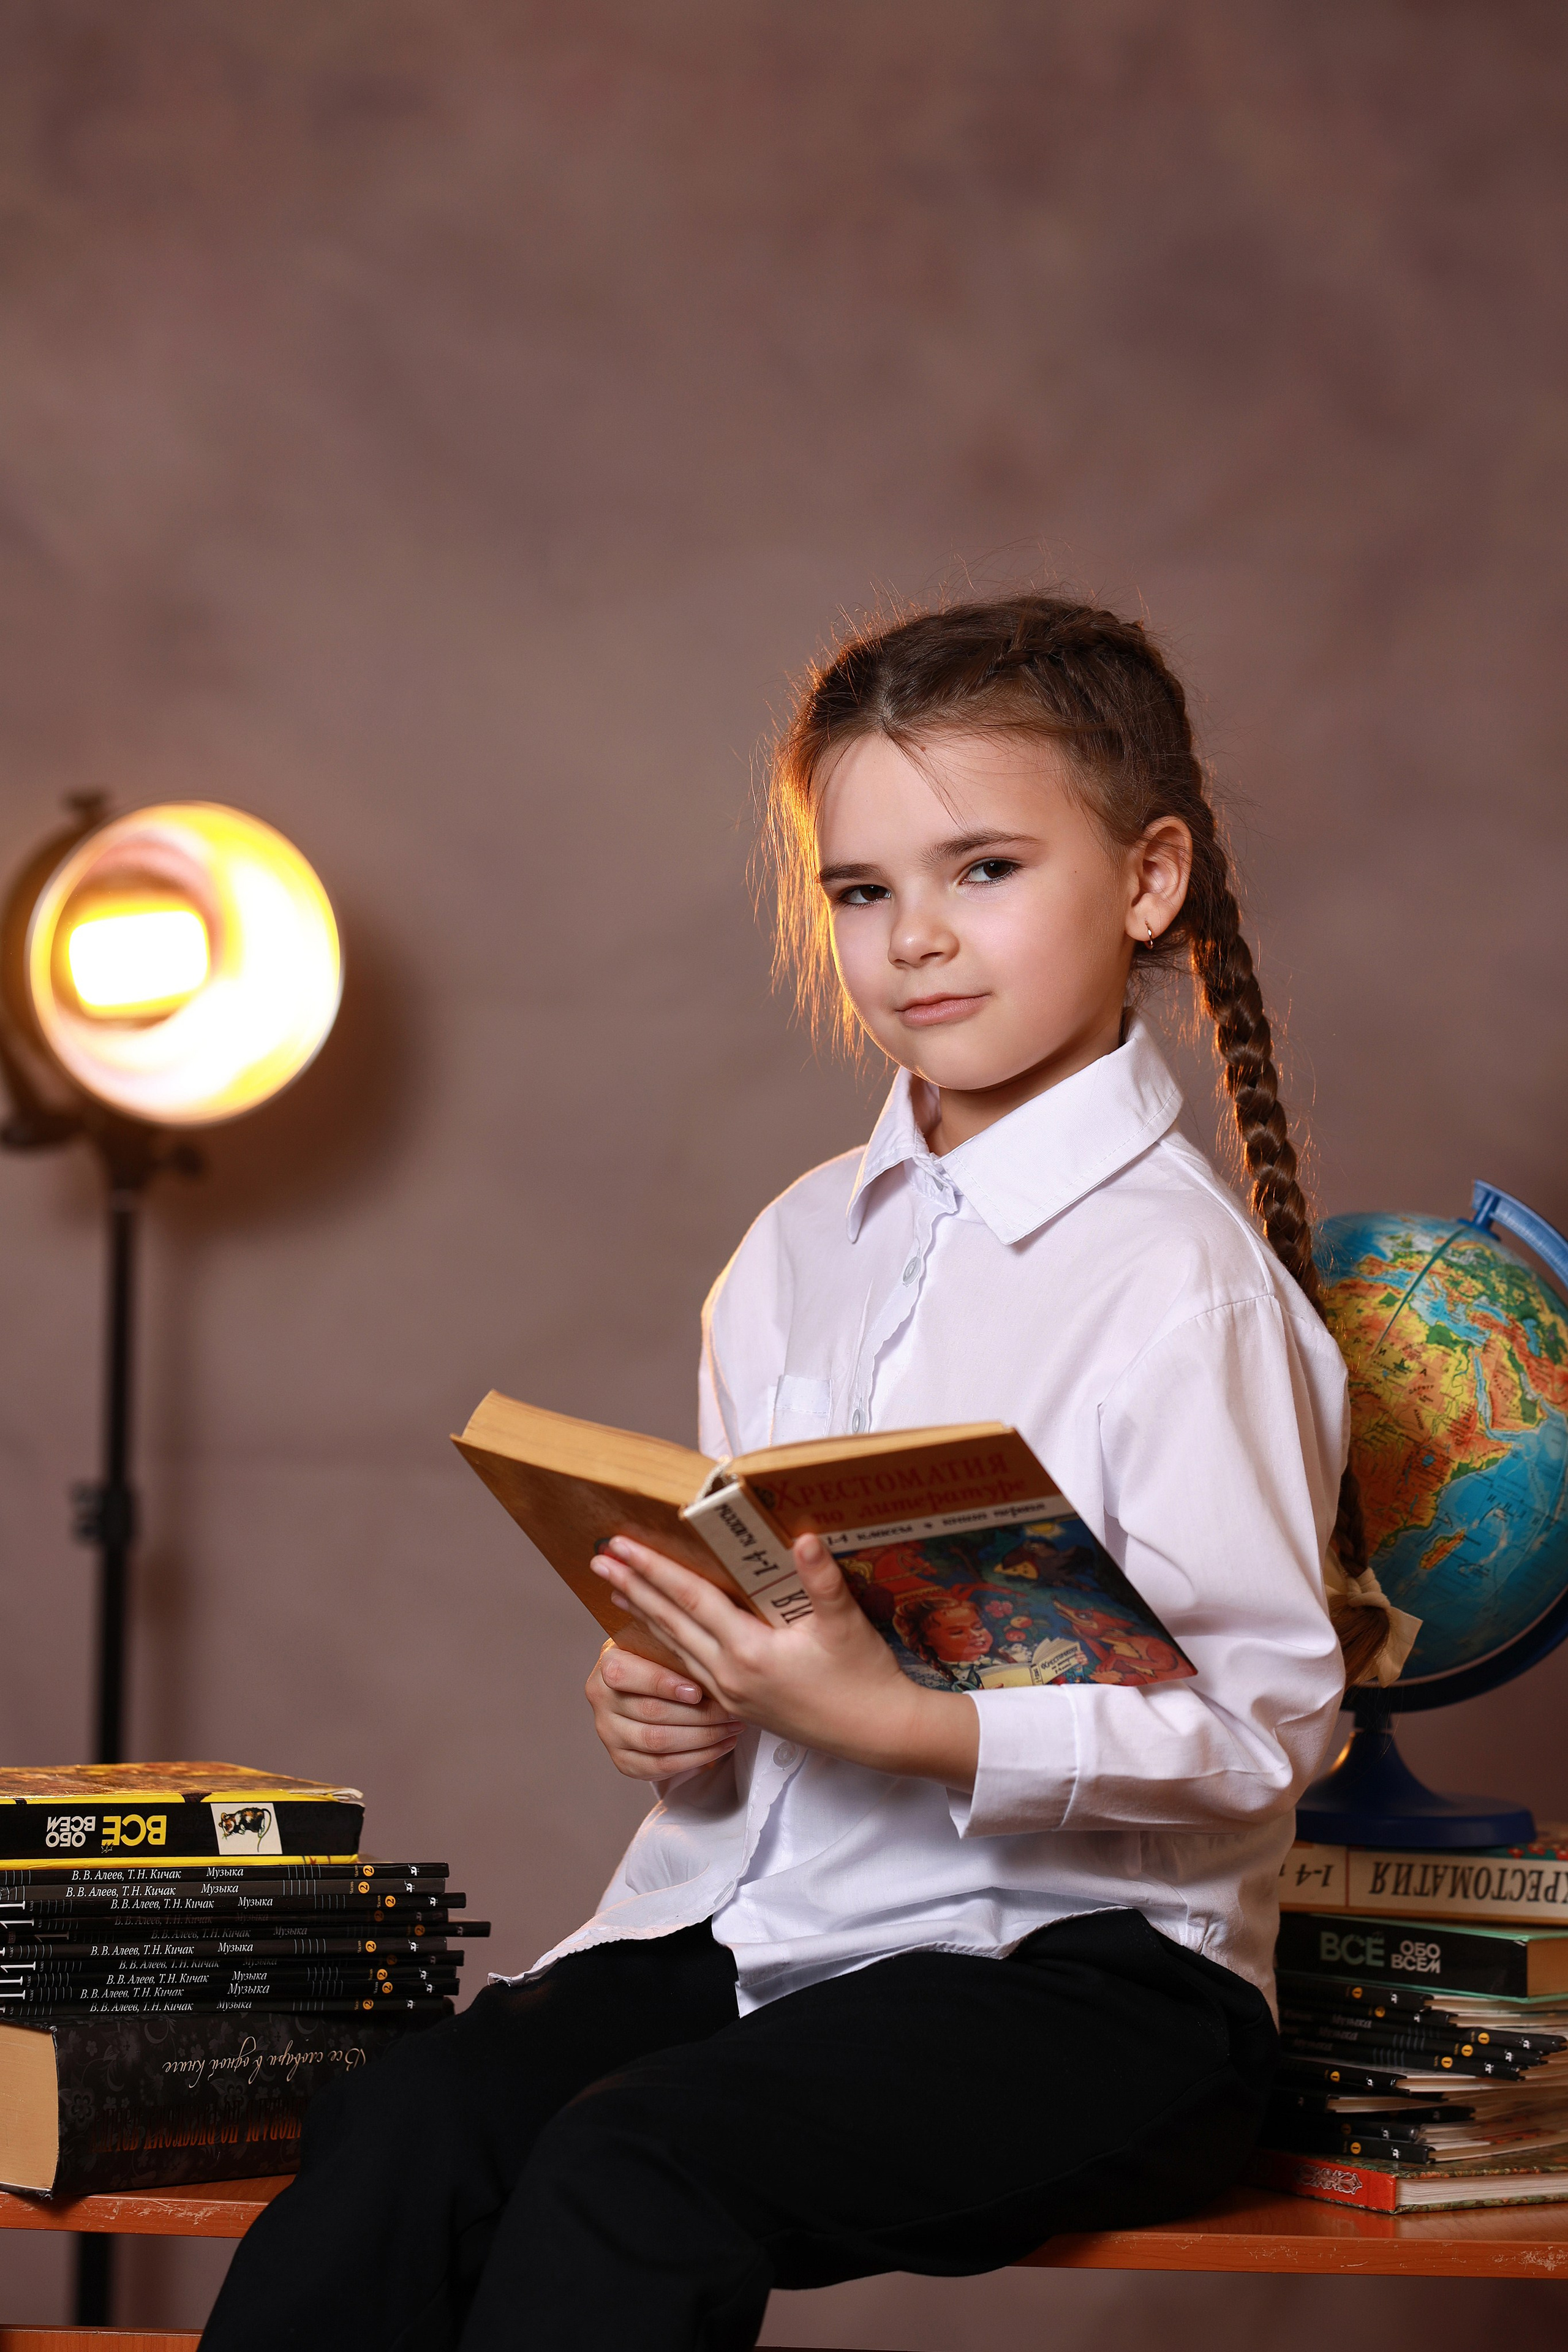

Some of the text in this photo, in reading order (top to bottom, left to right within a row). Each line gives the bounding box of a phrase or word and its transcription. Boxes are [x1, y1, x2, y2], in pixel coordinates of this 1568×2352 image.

[767, 1453, 1009, 1511] ХРЕСТОМАТИЯ
[812, 1510, 845, 1525] по
[742, 1550, 779, 1577] 1-4
[47, 1816, 96, 1833] ВСЕМ
[45, 1831, 86, 1847] ОБО
[94, 1869, 124, 1881] Алеев,
[151, 1869, 181, 1879] Кичак
[206, 1867, 244, 1880] Музыка
[1295, 1863, 1334, 1888] 1-4
[88, 1887, 118, 1898] Алеев,
[145, 1886, 176, 1896] Кичак
[200, 1883, 239, 1894] Музыка
[132, 1899, 160, 1910] Алеев,
[185, 1899, 214, 1909] Кичак
[237, 1896, 273, 1909] Музыка
[273, 1926, 307, 1937] Музыка
[112, 1945, 140, 1956] Алеев,
[165, 1945, 195, 1954] Кичак
[217, 1942, 254, 1954] Музыка
[1399, 1939, 1442, 1959] ОБО
[1390, 1953, 1442, 1974] ВСЕМ
[127, 1974, 156, 1985] Алеев,
[180, 1973, 209, 1983] Кичак
[232, 1970, 267, 1982] Музыка
[101, 1988, 129, 2000] Алеев,
[154, 1987, 184, 1997] Кичак
[227, 1983, 270, 1997] Музыка
[111, 2002, 140, 2013] Алеев,
[164, 2001, 194, 2011] Кичак
[216, 1999, 252, 2011] Музыка
[162, 2036, 366, 2089] Все словари в одной книге
